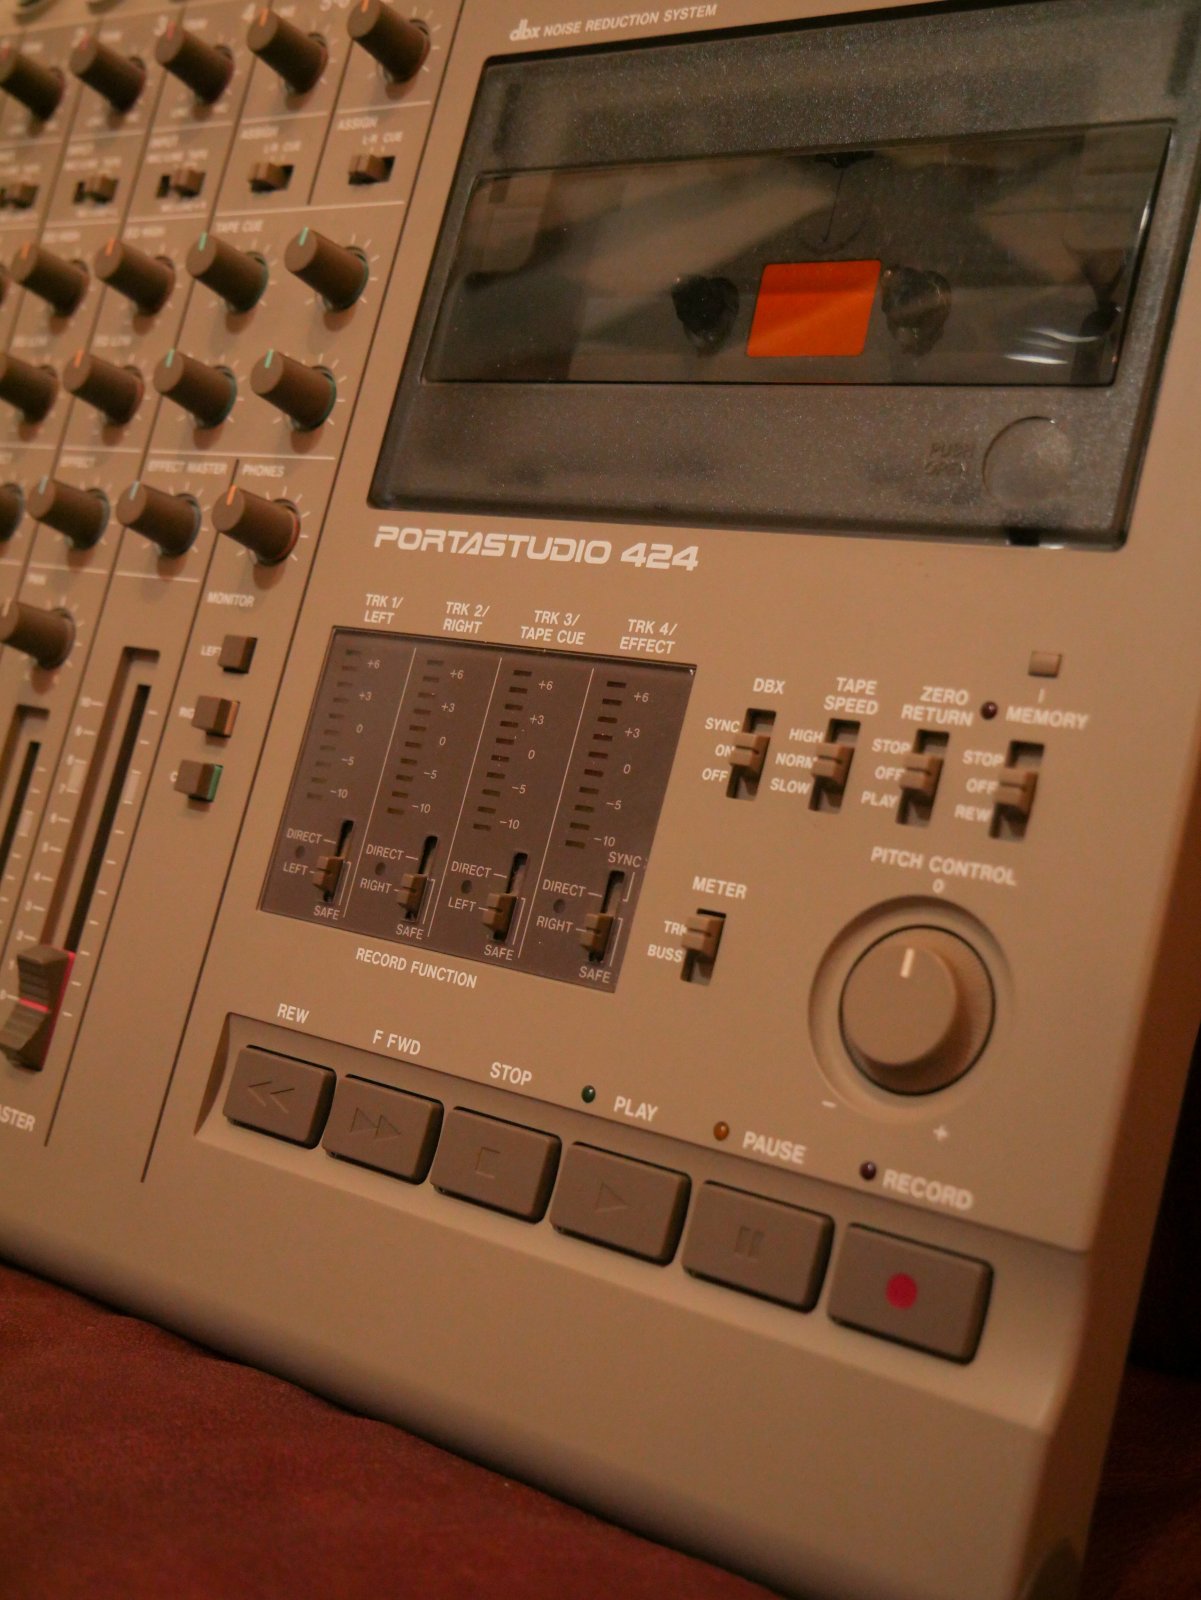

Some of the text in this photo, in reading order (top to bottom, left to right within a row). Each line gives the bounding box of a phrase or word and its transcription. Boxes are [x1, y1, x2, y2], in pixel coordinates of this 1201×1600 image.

[509, 4, 718, 41] dbx NOISE REDUCTION SYSTEM
[242, 464, 285, 478] PHONES
[374, 526, 699, 571] PORTASTUDIO 424
[206, 591, 255, 608] MONITOR
[365, 593, 404, 609] TRK 1/
[364, 610, 395, 625] LEFT
[446, 601, 490, 618] TRK 2/
[534, 609, 581, 627] TRK 3/
[442, 618, 483, 634] RIGHT
[627, 618, 678, 637] TRK 4/
[520, 625, 586, 646] TAPE CUE
[619, 636, 676, 655] EFFECT
[366, 659, 381, 669] +6
[449, 669, 465, 680] +6
[538, 680, 554, 691] +6
[753, 677, 785, 695] DBX
[836, 676, 877, 696] TAPE
[358, 690, 372, 701] +3
[633, 691, 650, 703] +6
[920, 685, 969, 706] ZERO
[440, 702, 456, 713] +3
[823, 694, 879, 716] SPEED
[529, 714, 546, 726] +3
[901, 703, 974, 727] RETURN
[1006, 705, 1090, 731] MEMORY
[356, 724, 363, 734] 0
[624, 726, 641, 739] +3
[705, 716, 741, 733] SYNC
[439, 736, 447, 746] 0
[788, 728, 824, 744] HIGH
[528, 749, 535, 759] 0
[872, 738, 911, 755] STOP
[962, 749, 1005, 768] STOP
[623, 764, 631, 774] 0
[701, 768, 729, 783] OFF
[769, 777, 811, 796] SLOW
[965, 777, 998, 795] OFF
[861, 790, 899, 809] PLAY
[954, 803, 994, 823] REW
[286, 828, 323, 844] DIRECT
[365, 844, 404, 861] DIRECT
[608, 851, 642, 868] SYNC
[283, 861, 308, 876] LEFT
[451, 860, 492, 878] DIRECT
[870, 846, 1017, 886] PITCH CONTROL
[360, 877, 392, 894] RIGHT
[542, 879, 586, 898] DIRECT
[692, 876, 748, 900] METER
[932, 879, 945, 893] 0
[313, 905, 341, 920] SAFE
[448, 896, 476, 913] LEFT
[396, 923, 424, 940] SAFE
[536, 915, 574, 933] RIGHT
[484, 944, 514, 961] SAFE
[647, 944, 683, 963] BUSS
[356, 947, 477, 989] RECORD FUNCTION
[579, 966, 611, 984] SAFE
[276, 1003, 310, 1024] REW
[373, 1029, 421, 1055] F FWD
[490, 1061, 532, 1086] STOP
[614, 1096, 659, 1122] PLAY
[742, 1131, 807, 1165] PAUSE
[882, 1168, 974, 1211] RECORD
